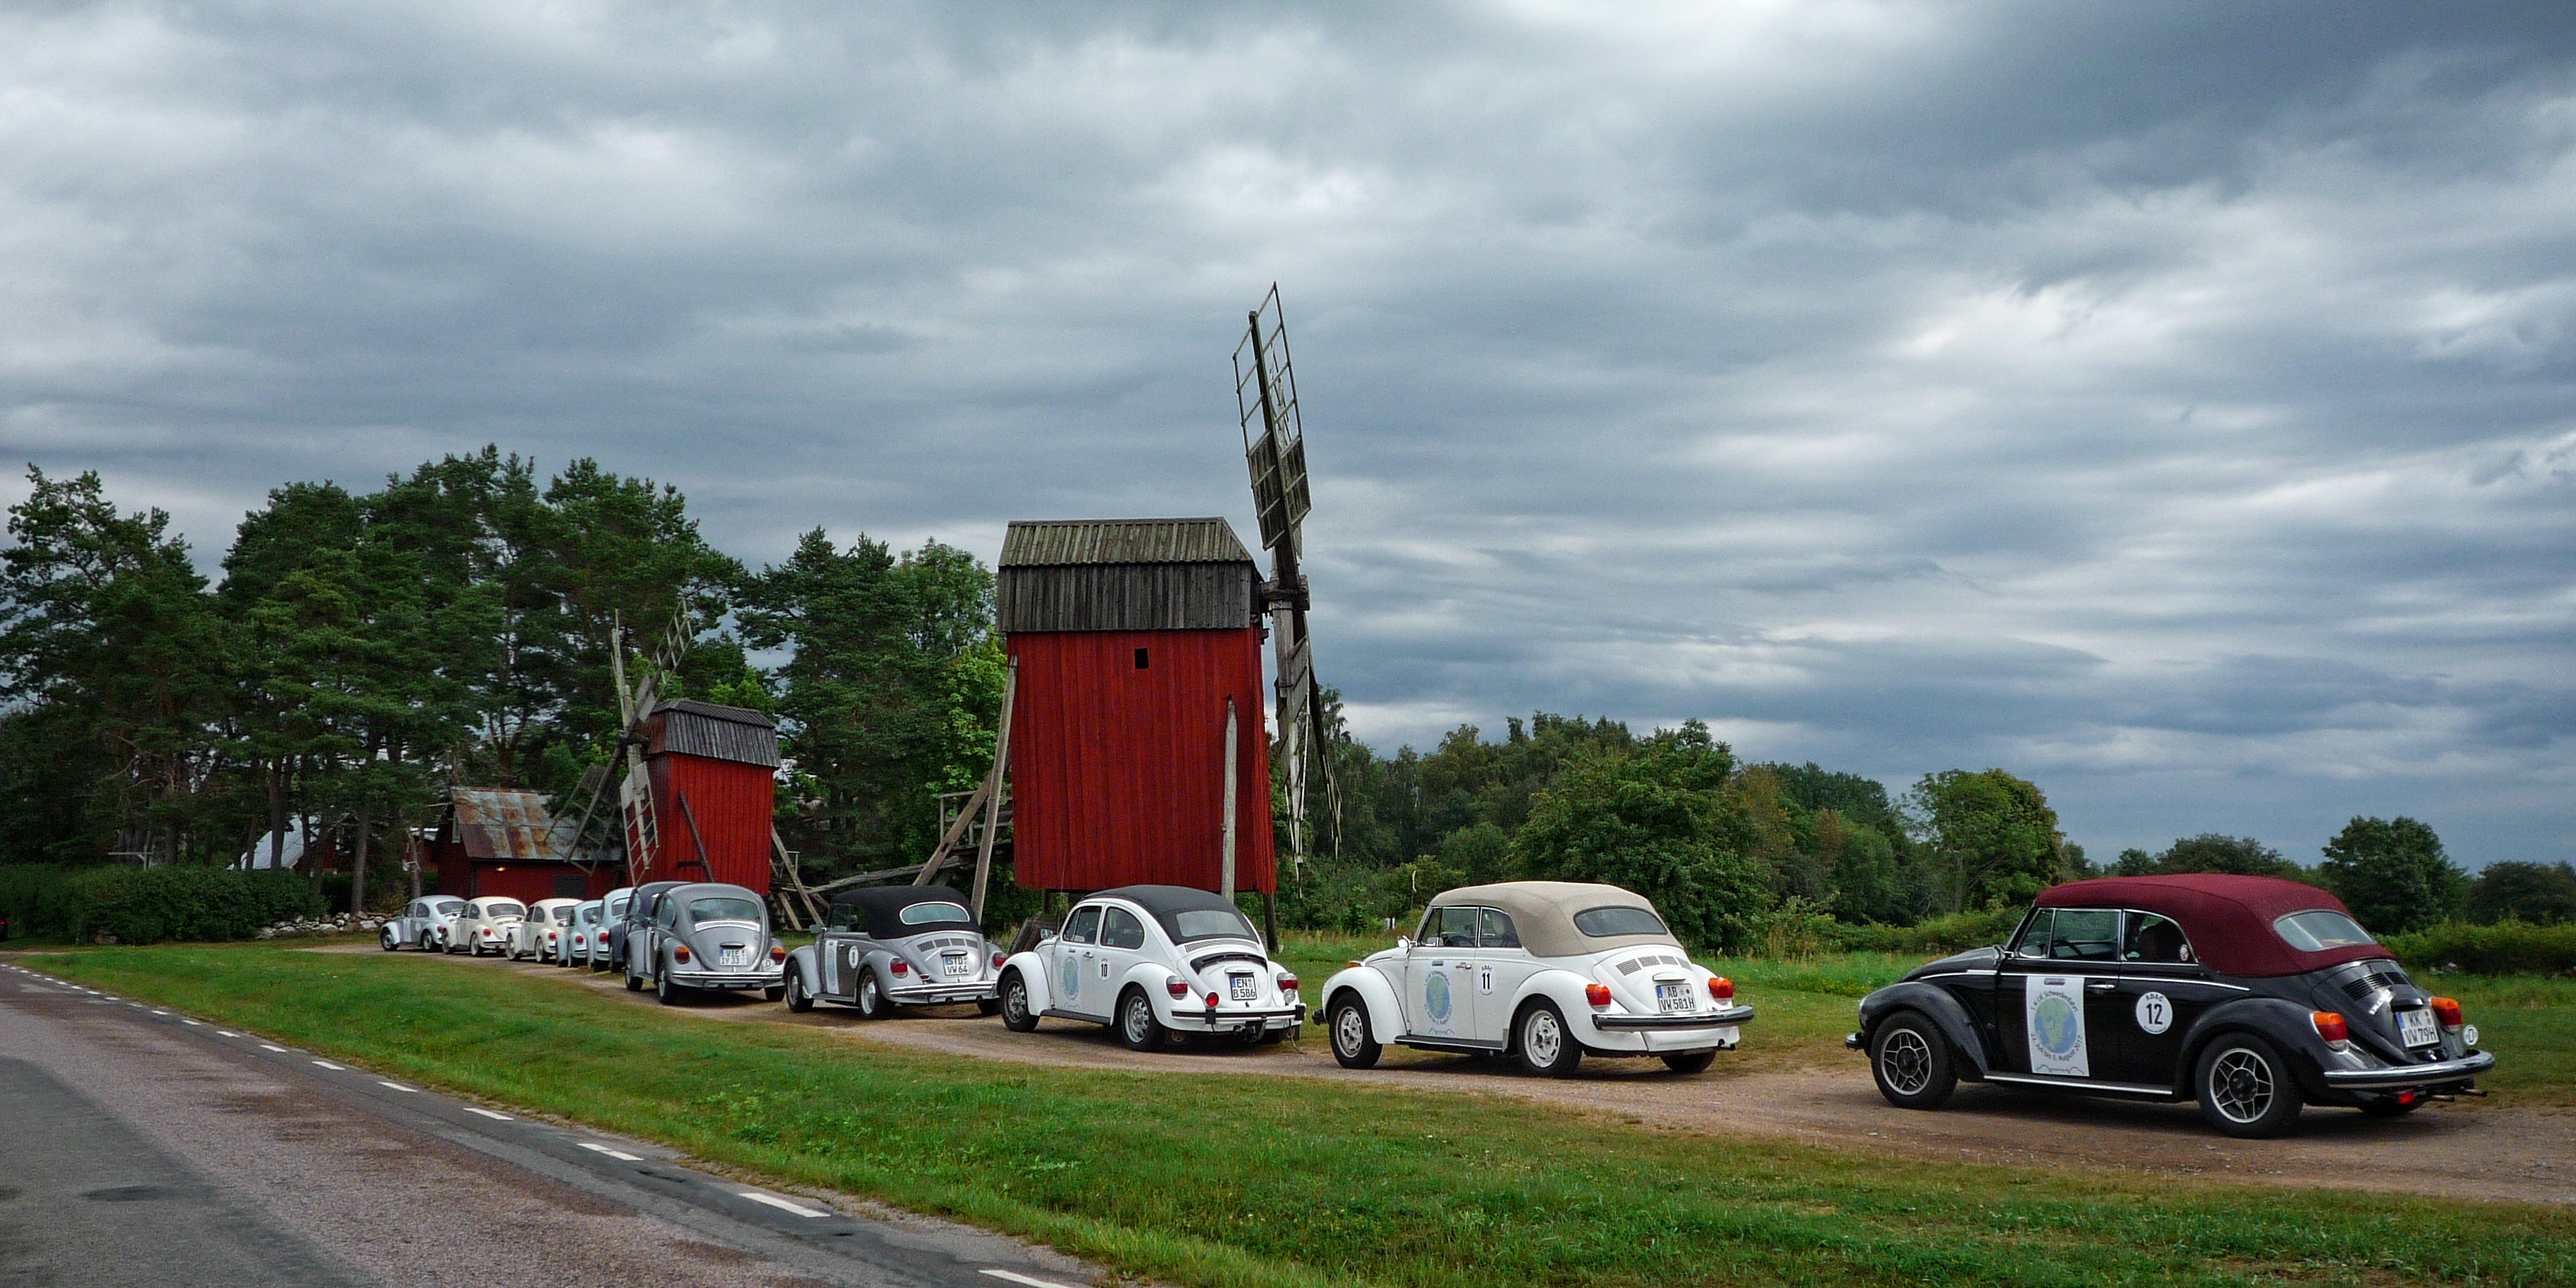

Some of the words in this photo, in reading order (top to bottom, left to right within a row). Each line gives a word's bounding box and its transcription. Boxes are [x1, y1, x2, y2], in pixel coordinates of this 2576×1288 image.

[948, 957, 963, 965] STD
[958, 965, 968, 973] 64
[1101, 963, 1108, 977] 10
[1236, 978, 1248, 988] EN
[1481, 972, 1491, 990] 11
[1233, 989, 1239, 998] B
[1240, 988, 1256, 998] 586
[1667, 986, 1678, 998] AB
[2145, 993, 2164, 1002] ADAC
[1660, 999, 1672, 1010] VW
[1673, 996, 1695, 1010] 581H
[2146, 1003, 2164, 1025] 12
[2408, 1011, 2422, 1027] KK
[2404, 1030, 2419, 1044] VW
[2419, 1027, 2436, 1042] 79H
[2468, 1028, 2474, 1043] D
